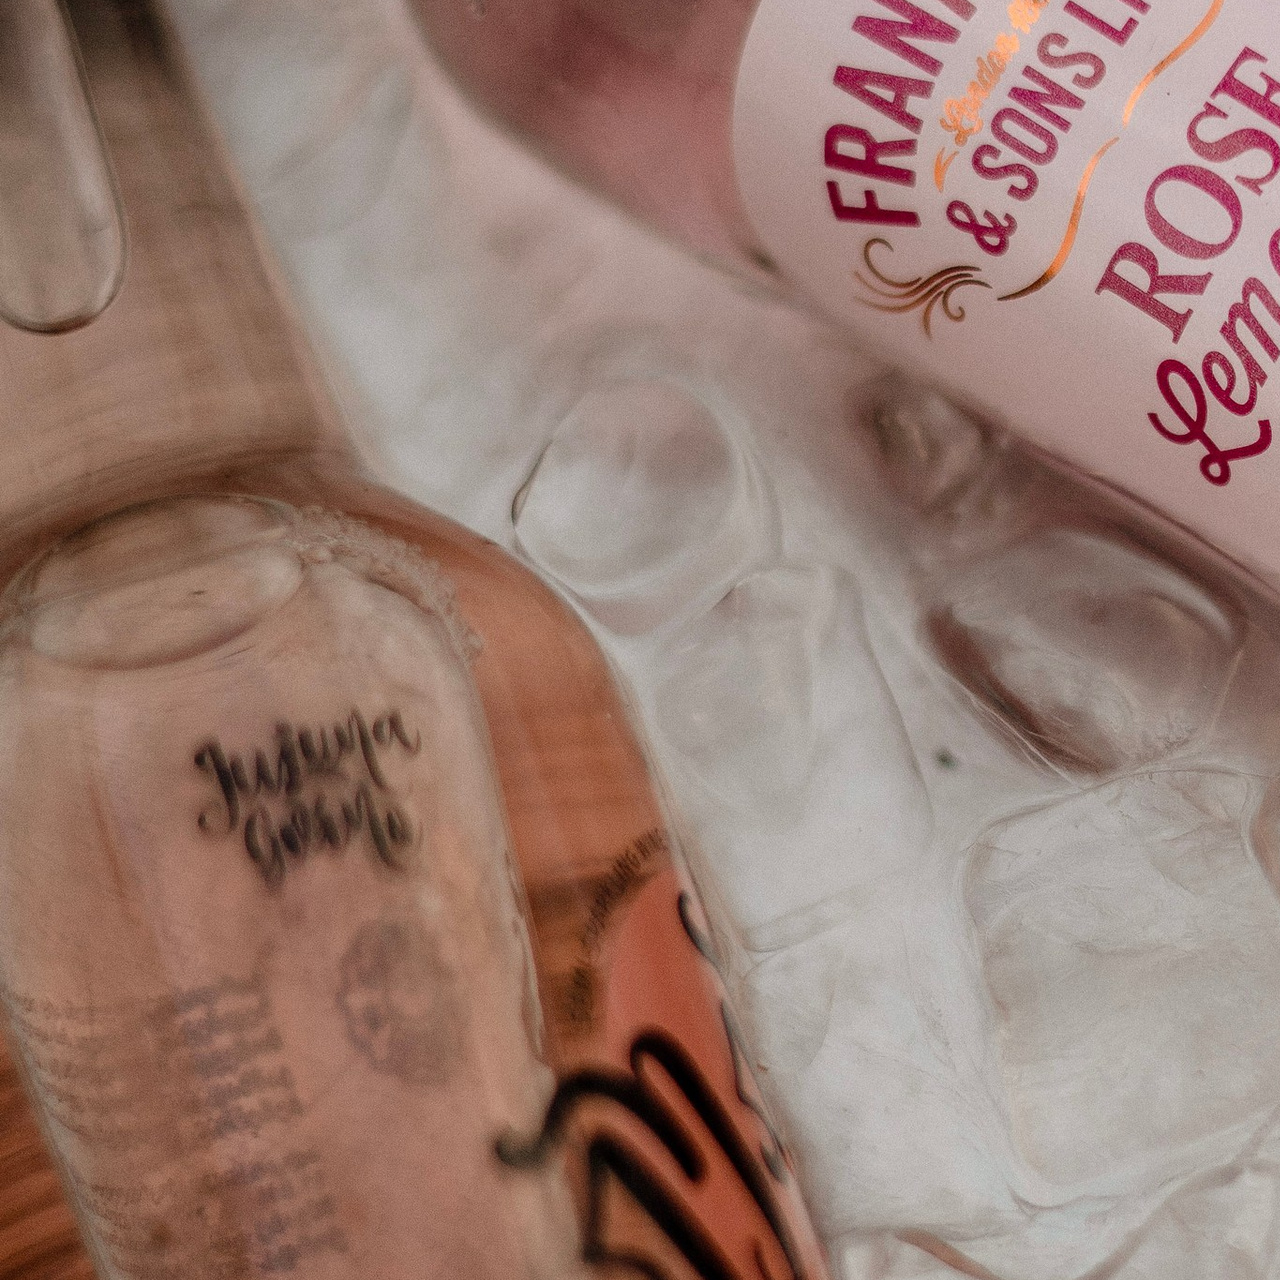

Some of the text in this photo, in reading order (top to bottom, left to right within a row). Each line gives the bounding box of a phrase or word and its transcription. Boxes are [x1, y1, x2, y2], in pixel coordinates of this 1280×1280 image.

[937, 32, 1021, 147] London
[970, 32, 1107, 203] SONS
[945, 199, 1017, 258] &
